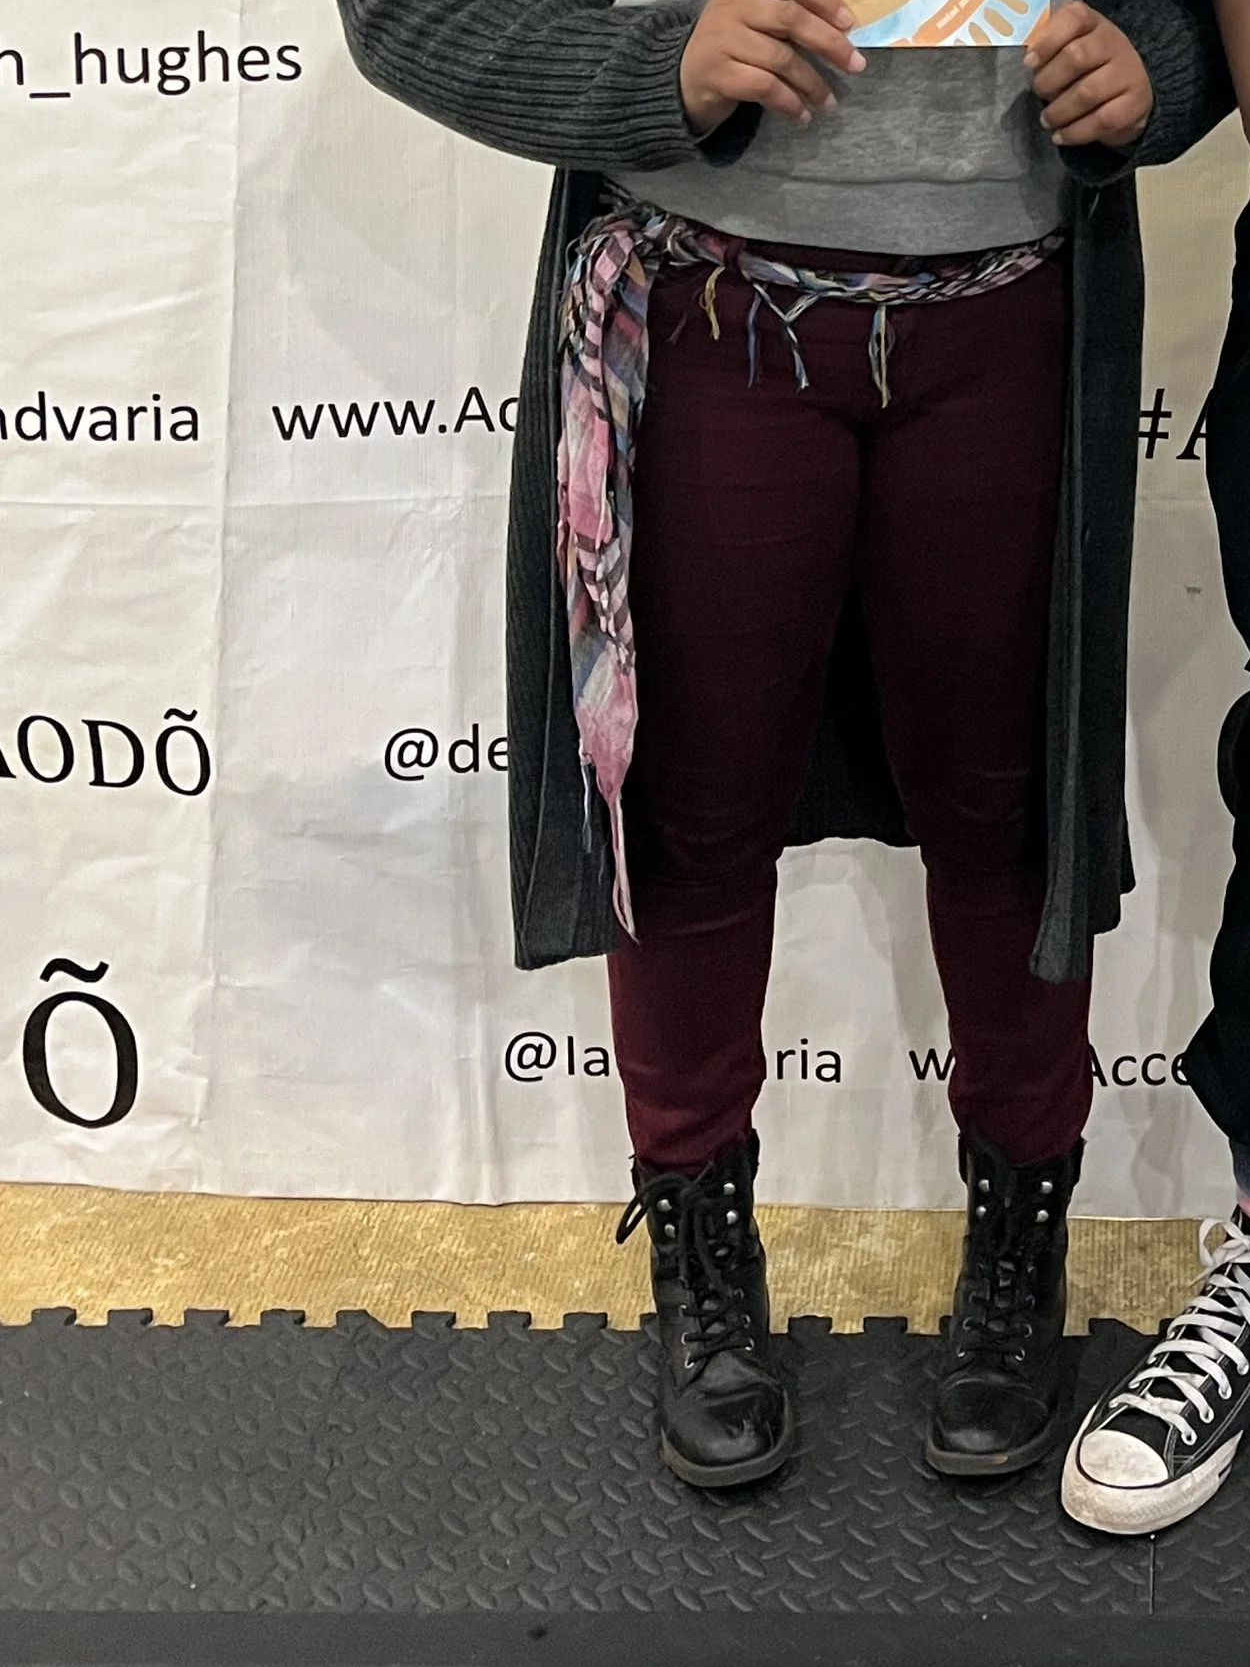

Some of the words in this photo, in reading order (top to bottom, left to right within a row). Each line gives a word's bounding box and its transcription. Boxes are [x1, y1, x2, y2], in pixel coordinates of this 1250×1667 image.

[0, 390, 200, 443] dvaria
[0, 708, 212, 797] ODÕ
[21, 956, 140, 1130] Õ
